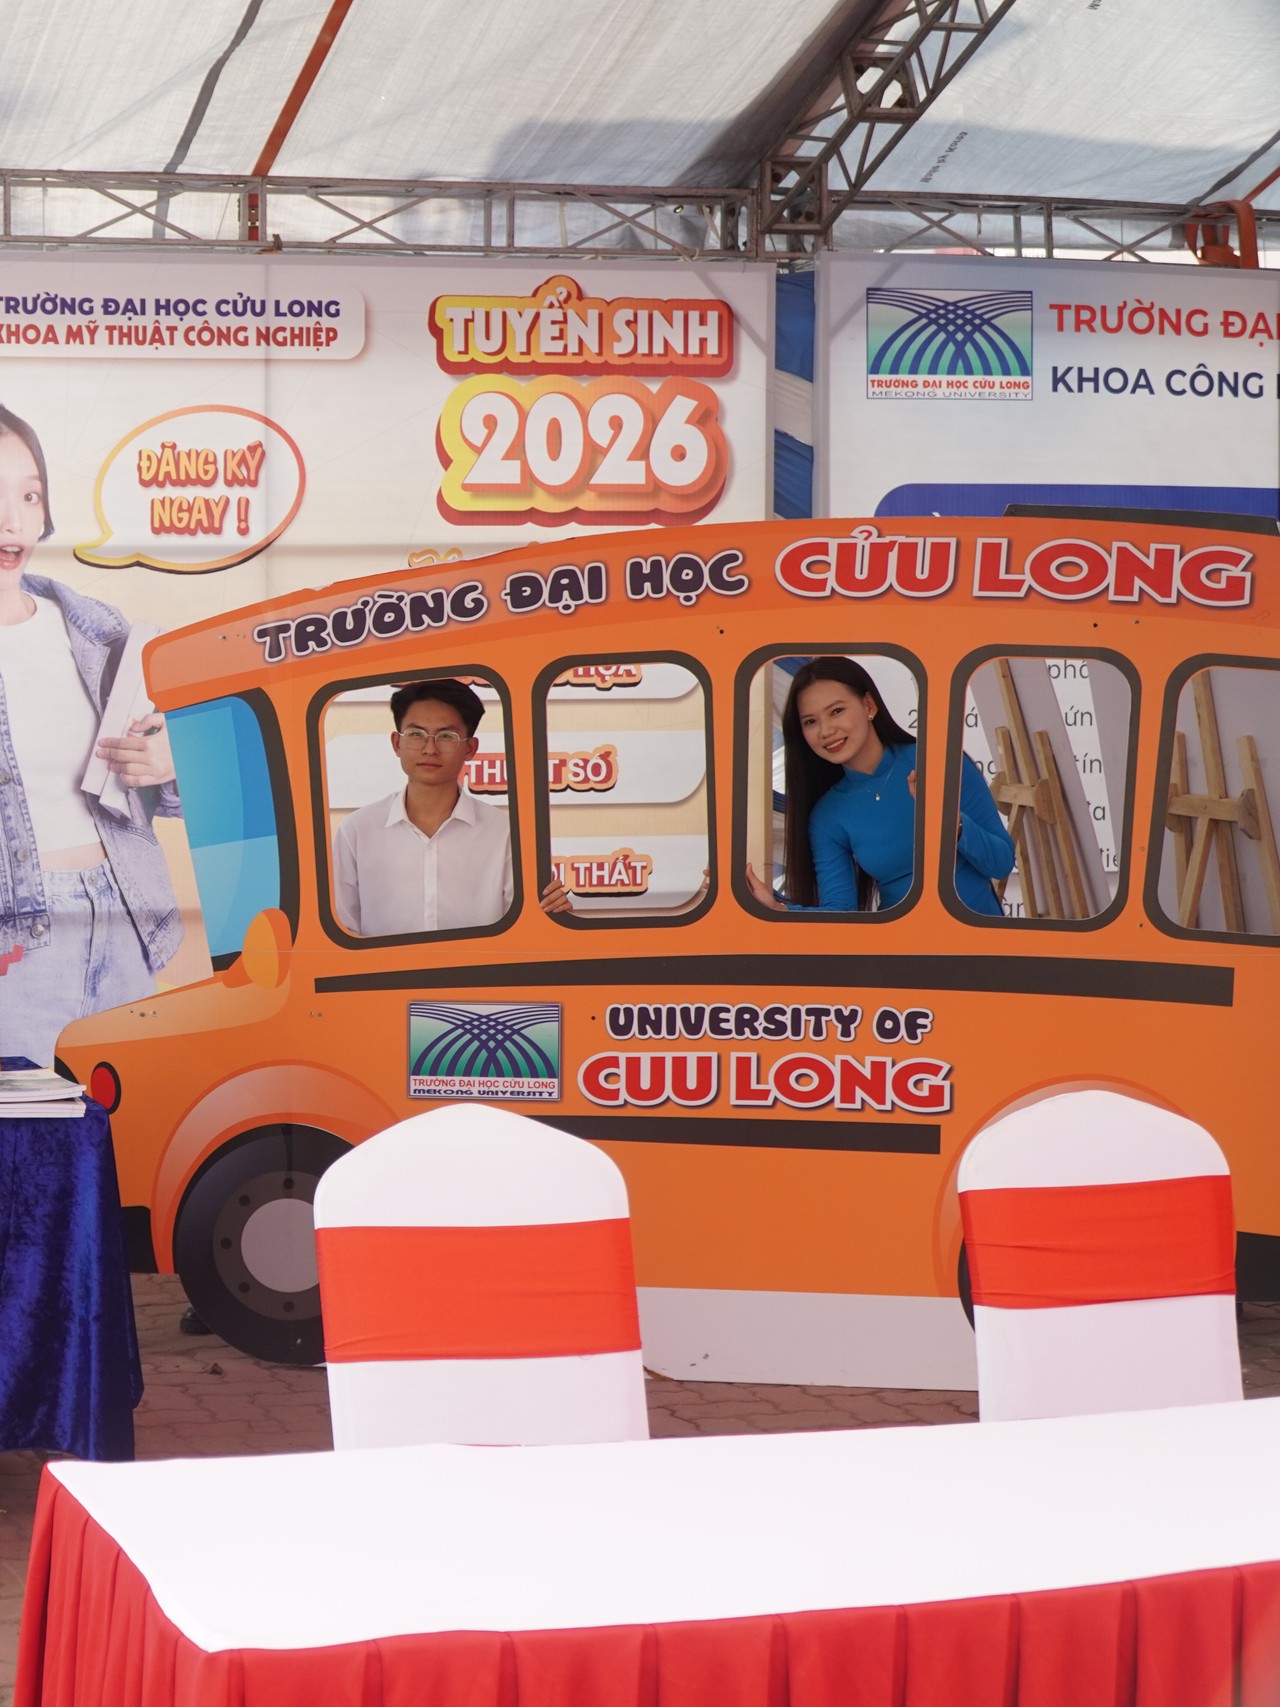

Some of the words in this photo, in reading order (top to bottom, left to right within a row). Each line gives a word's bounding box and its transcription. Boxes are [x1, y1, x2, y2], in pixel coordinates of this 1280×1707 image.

[101, 297, 147, 322] ĐẠI
[154, 297, 208, 322] HỌC
[214, 292, 267, 318] CỬU
[274, 299, 341, 319] LONG
[444, 285, 602, 357] TUYỂN
[612, 306, 721, 358] SINH
[1049, 298, 1209, 338] TRƯỜNG
[65, 319, 100, 346] MỸ
[105, 319, 178, 350] THUẬT
[183, 320, 249, 348] CÔNG
[255, 321, 339, 352] NGHIỆP
[870, 377, 919, 389] TRƯỜNG
[922, 380, 942, 391] ĐẠI
[946, 380, 969, 391] HỌC
[972, 377, 996, 390] CỬU
[999, 380, 1030, 390] LONG
[872, 390, 938, 398] MEKONG
[943, 391, 1030, 399] UNIVERSITY
[1051, 366, 1155, 396] KHOA
[1165, 363, 1264, 399] CÔNG
[460, 391, 713, 493] 2026
[137, 441, 218, 488] ĐĂNG
[224, 440, 266, 488] KÝ
[151, 495, 230, 536] NGAY
[254, 582, 487, 662] TRƯỜNG
[501, 562, 608, 614] ĐẠI
[625, 551, 749, 606] HỌC
[775, 525, 959, 598] CỬU
[972, 537, 1254, 607] LONG
[567, 751, 611, 783] SỐ
[573, 855, 648, 887] THẤT
[606, 1003, 863, 1042] UNIVERSITY
[872, 1006, 933, 1044] OF
[412, 1078, 456, 1088] TRƯỜNG
[458, 1080, 476, 1090] ĐẠI
[478, 1080, 499, 1090] HỌC
[502, 1078, 524, 1089] CỬU
[528, 1081, 556, 1089] LONG
[413, 1088, 473, 1096] MEKONG
[478, 1089, 556, 1097] UNIVERSITY
[577, 1051, 719, 1106] CUU
[730, 1051, 952, 1113] LONG
